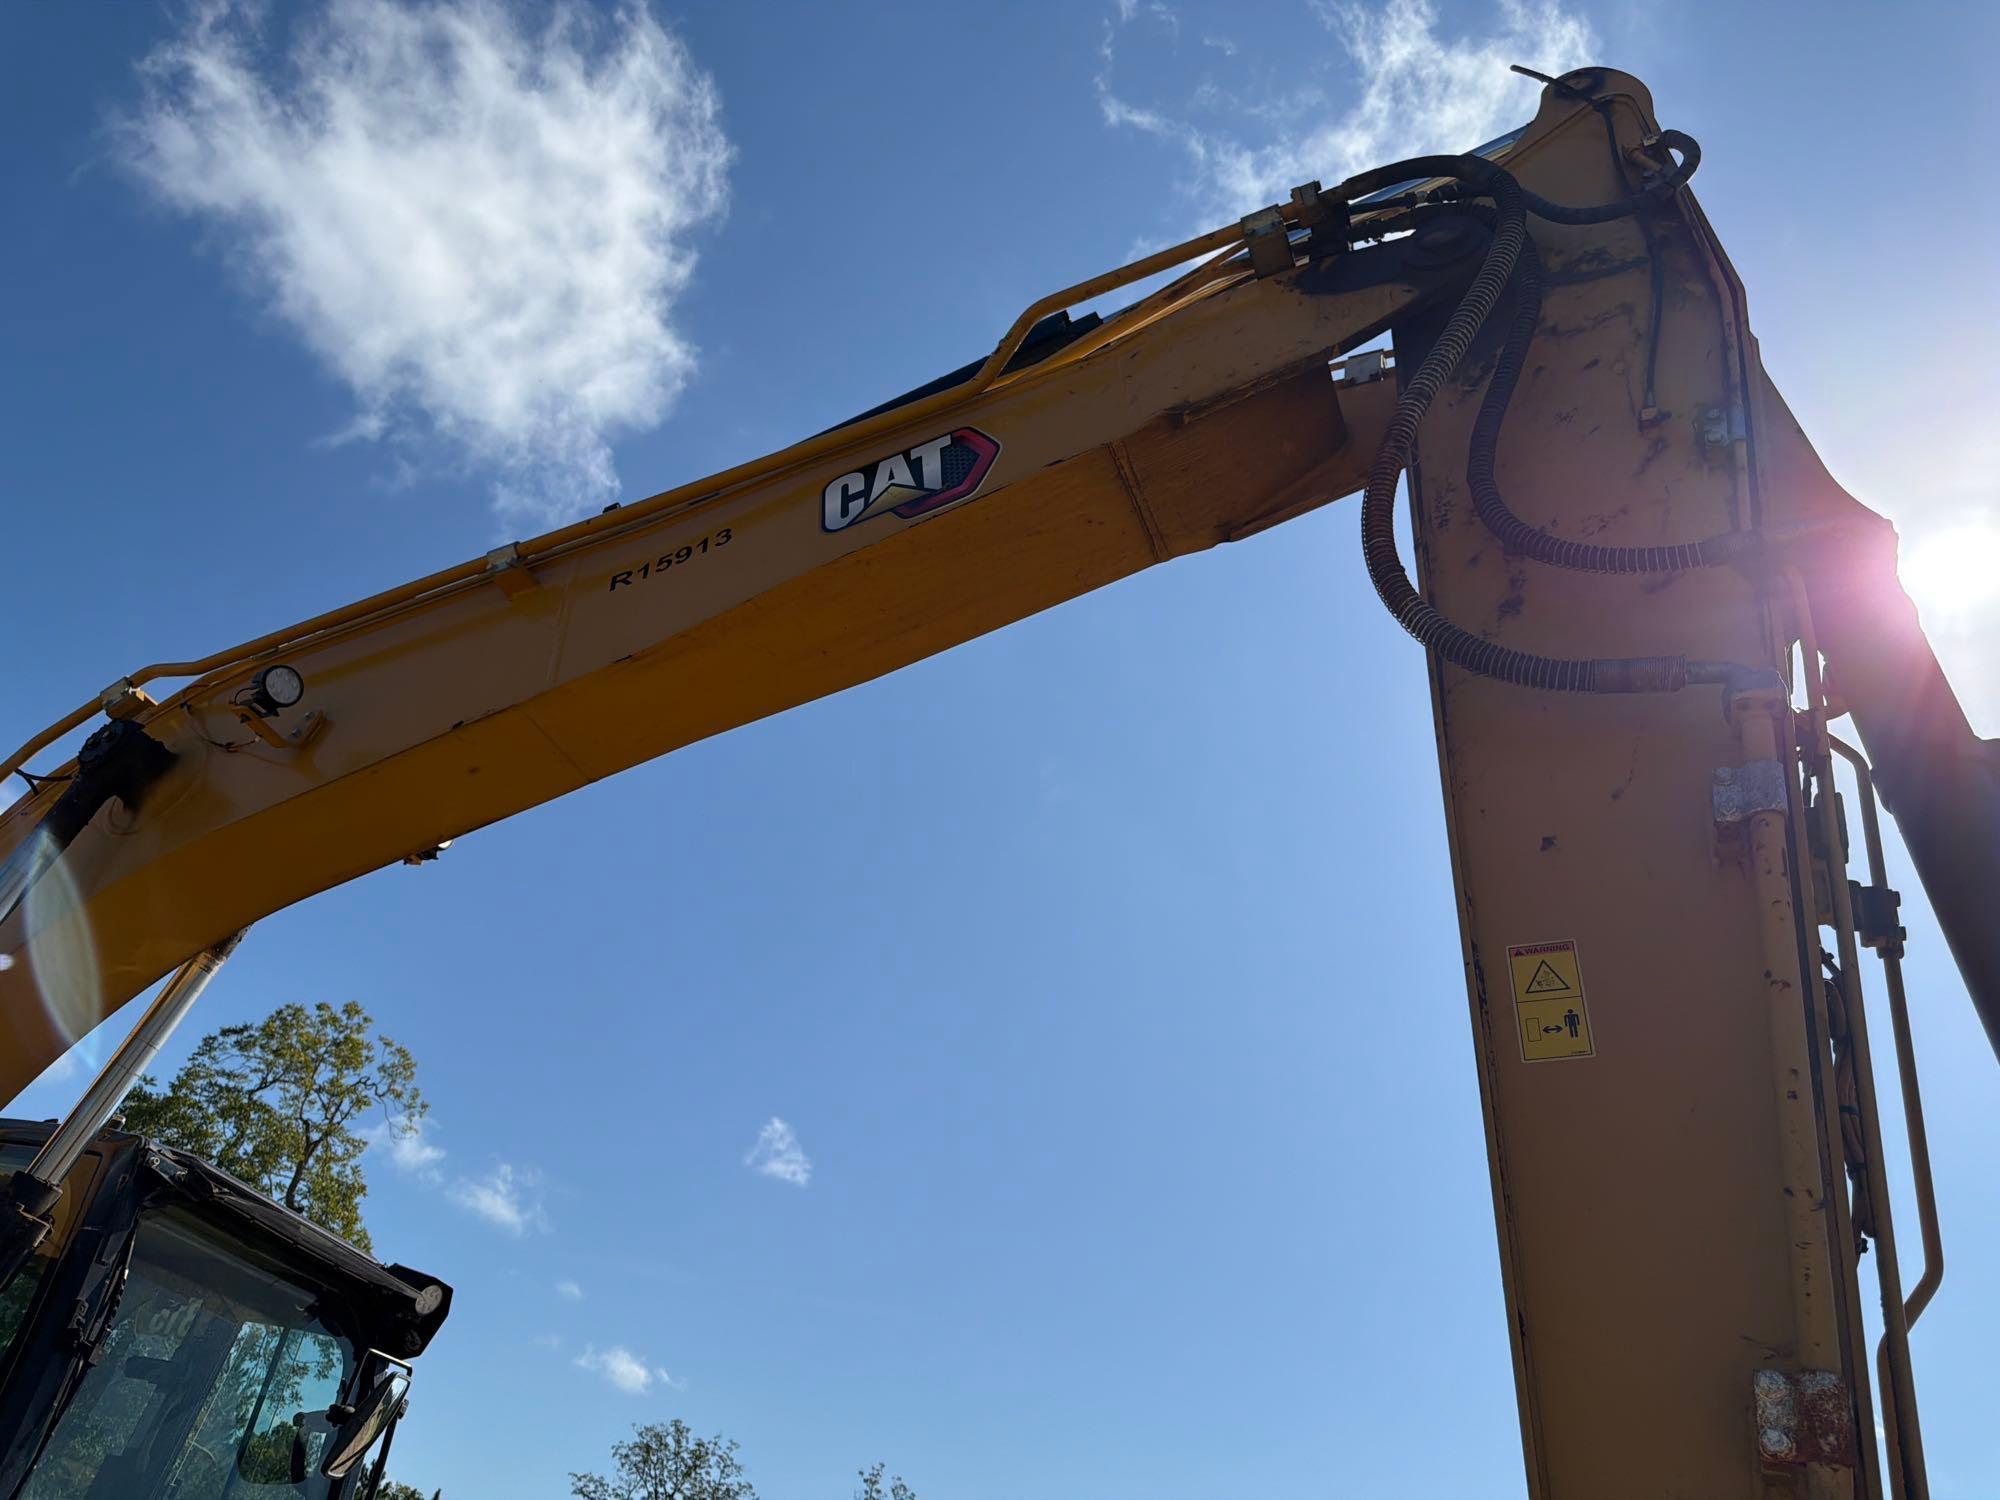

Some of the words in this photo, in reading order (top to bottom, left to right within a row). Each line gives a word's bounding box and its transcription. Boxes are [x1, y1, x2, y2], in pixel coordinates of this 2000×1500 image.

[824, 435, 952, 530] CAT
[609, 528, 732, 591] R15913
[1525, 944, 1570, 955] WARNING
